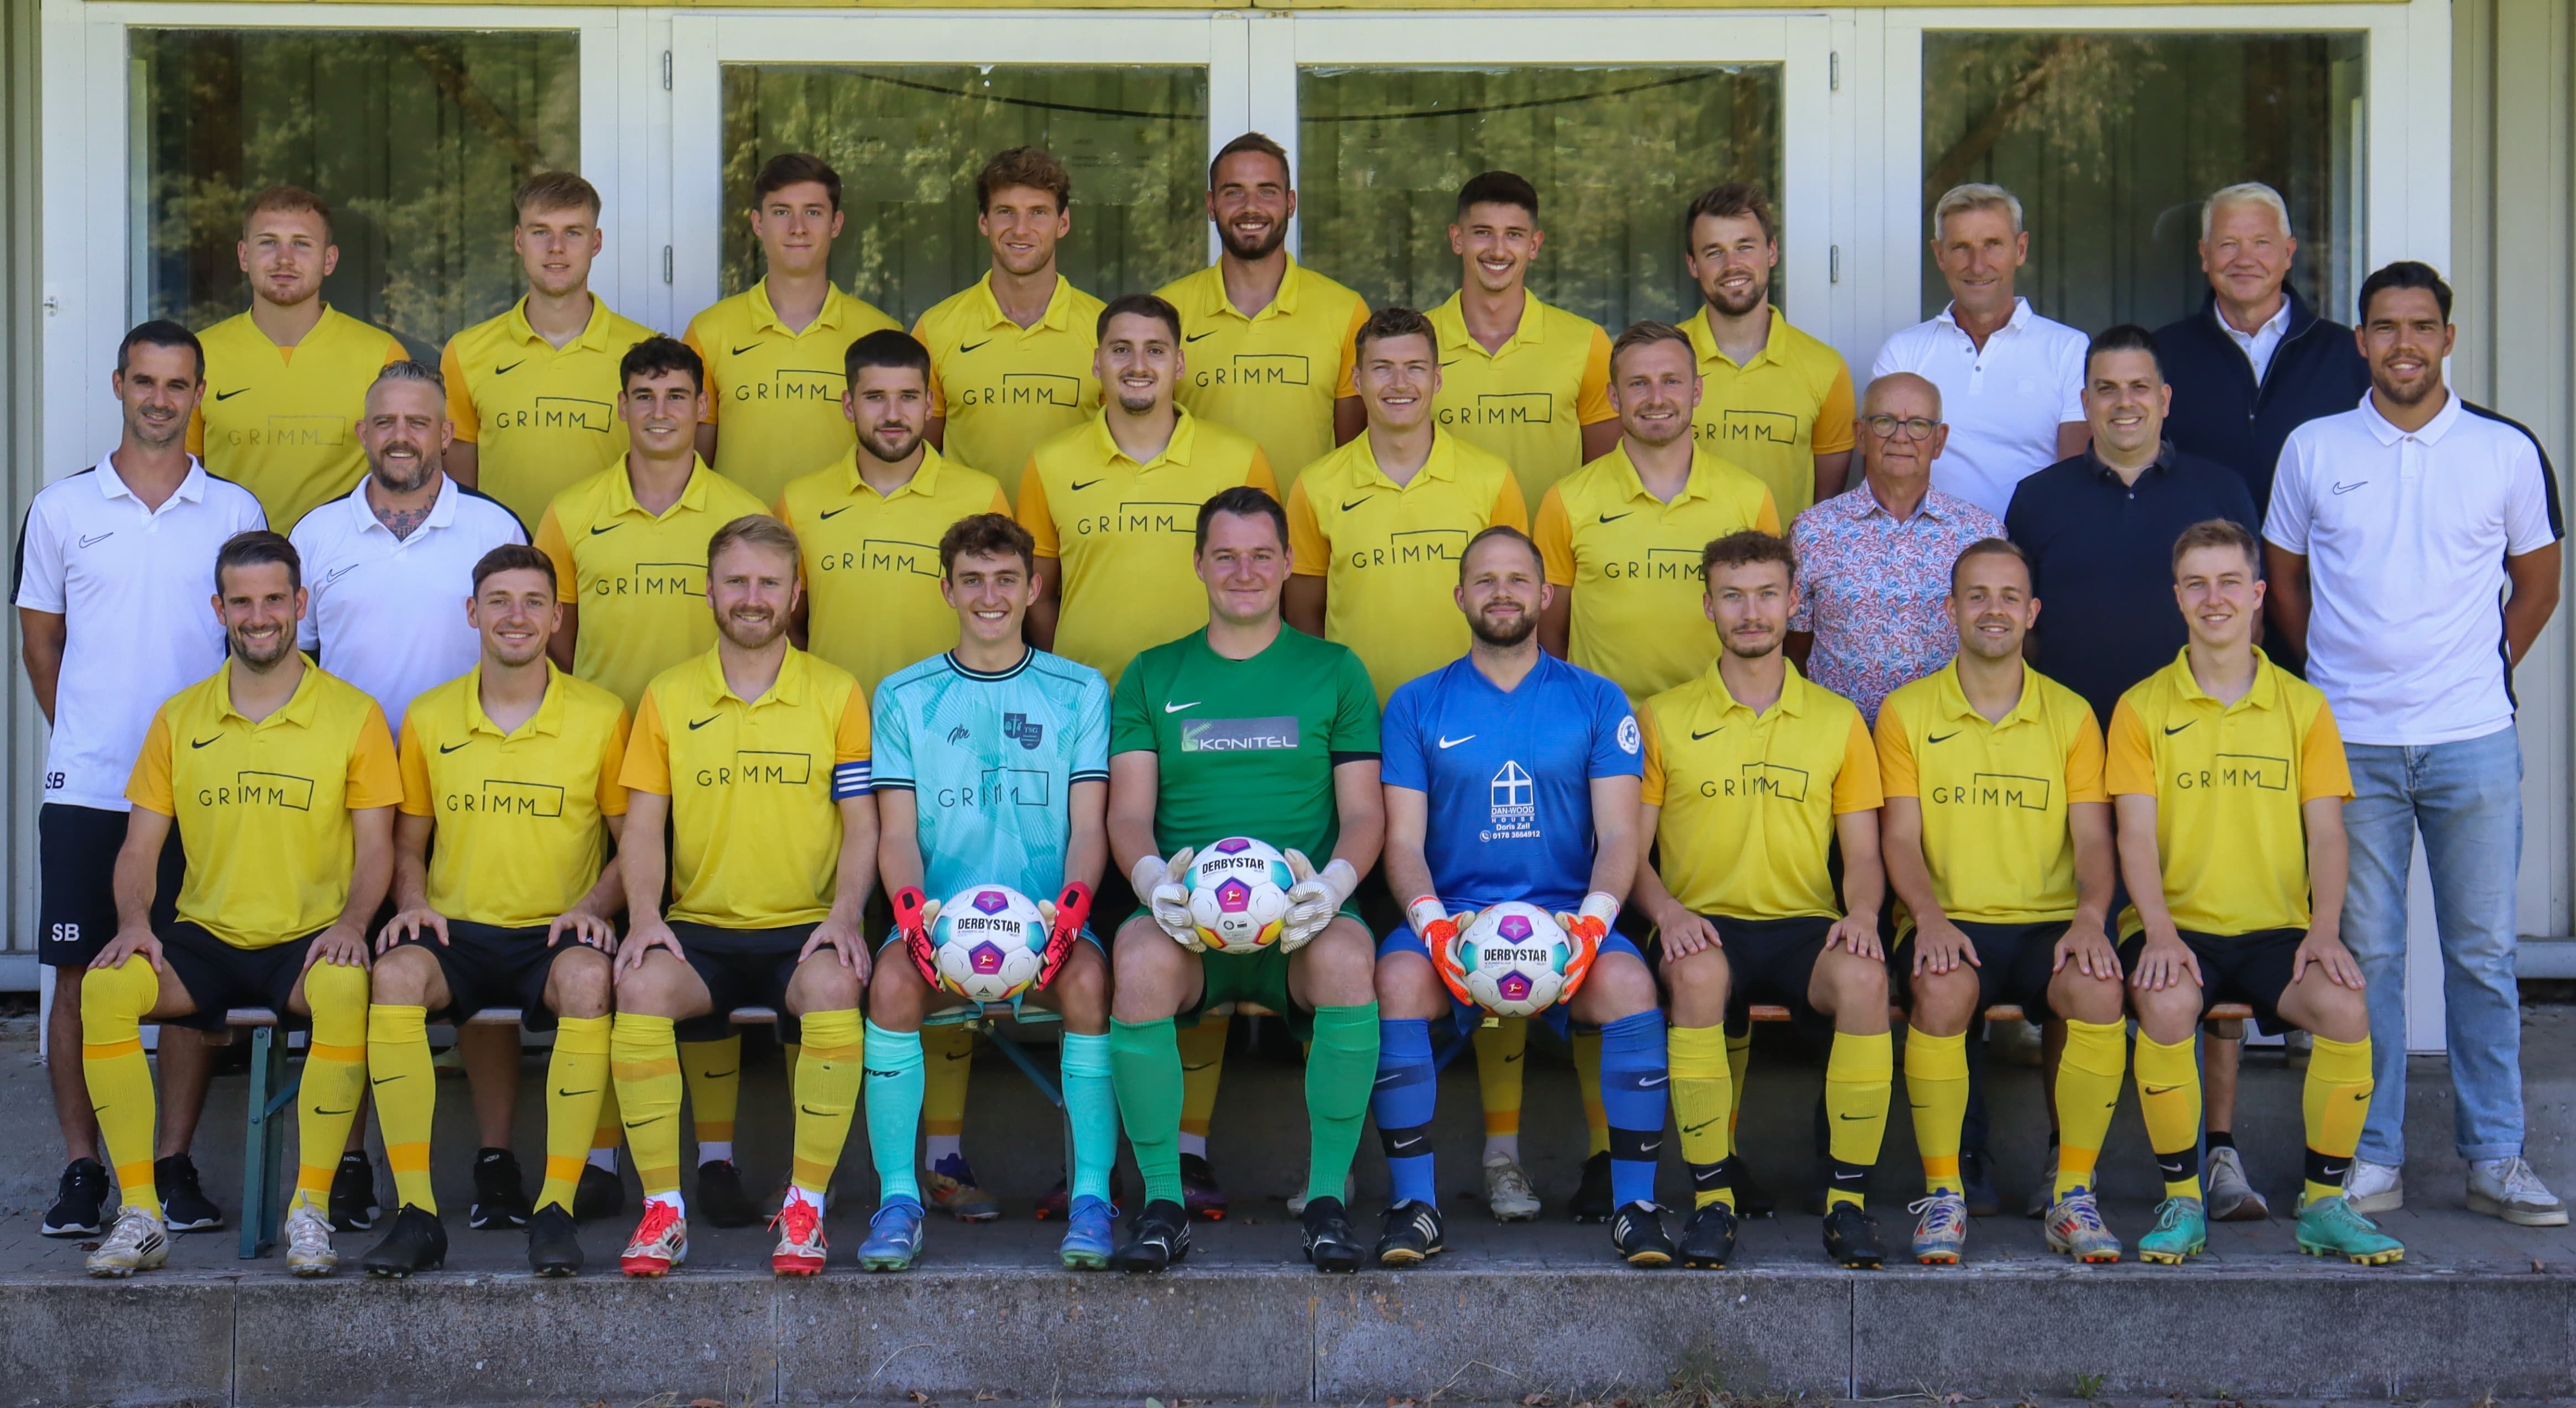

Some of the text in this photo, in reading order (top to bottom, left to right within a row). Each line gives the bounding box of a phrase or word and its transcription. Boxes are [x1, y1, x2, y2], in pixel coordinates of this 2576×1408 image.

[1196, 367, 1284, 387] GRIMM
[736, 383, 828, 401] GRIMM
[963, 388, 1053, 405] GRIMM
[497, 410, 586, 429] GRIMM
[1439, 406, 1526, 424] GRIMM
[228, 429, 319, 446] GRIMM
[1078, 515, 1173, 535] GRIMM
[821, 553, 914, 572] GRIMM
[1352, 544, 1443, 568] GRIMM
[1605, 562, 1702, 580] GRIMM
[596, 578, 686, 595] GRIMM
[45, 771, 65, 789] SB
[697, 766, 782, 786] GRMM
[2177, 769, 2260, 789] GRMM
[1701, 776, 1779, 797] GRIMM
[199, 786, 284, 806] GRIMM
[447, 794, 535, 815] GRIMM
[1933, 786, 2022, 806] GRIMM
[1492, 806, 1534, 815] DAN-WOOD
[1202, 858, 1264, 874] DERBYSTAR
[52, 923, 80, 941] SB
[958, 918, 1020, 934] DERBYSTAR
[1484, 949, 1547, 962] DERBYSTAR
